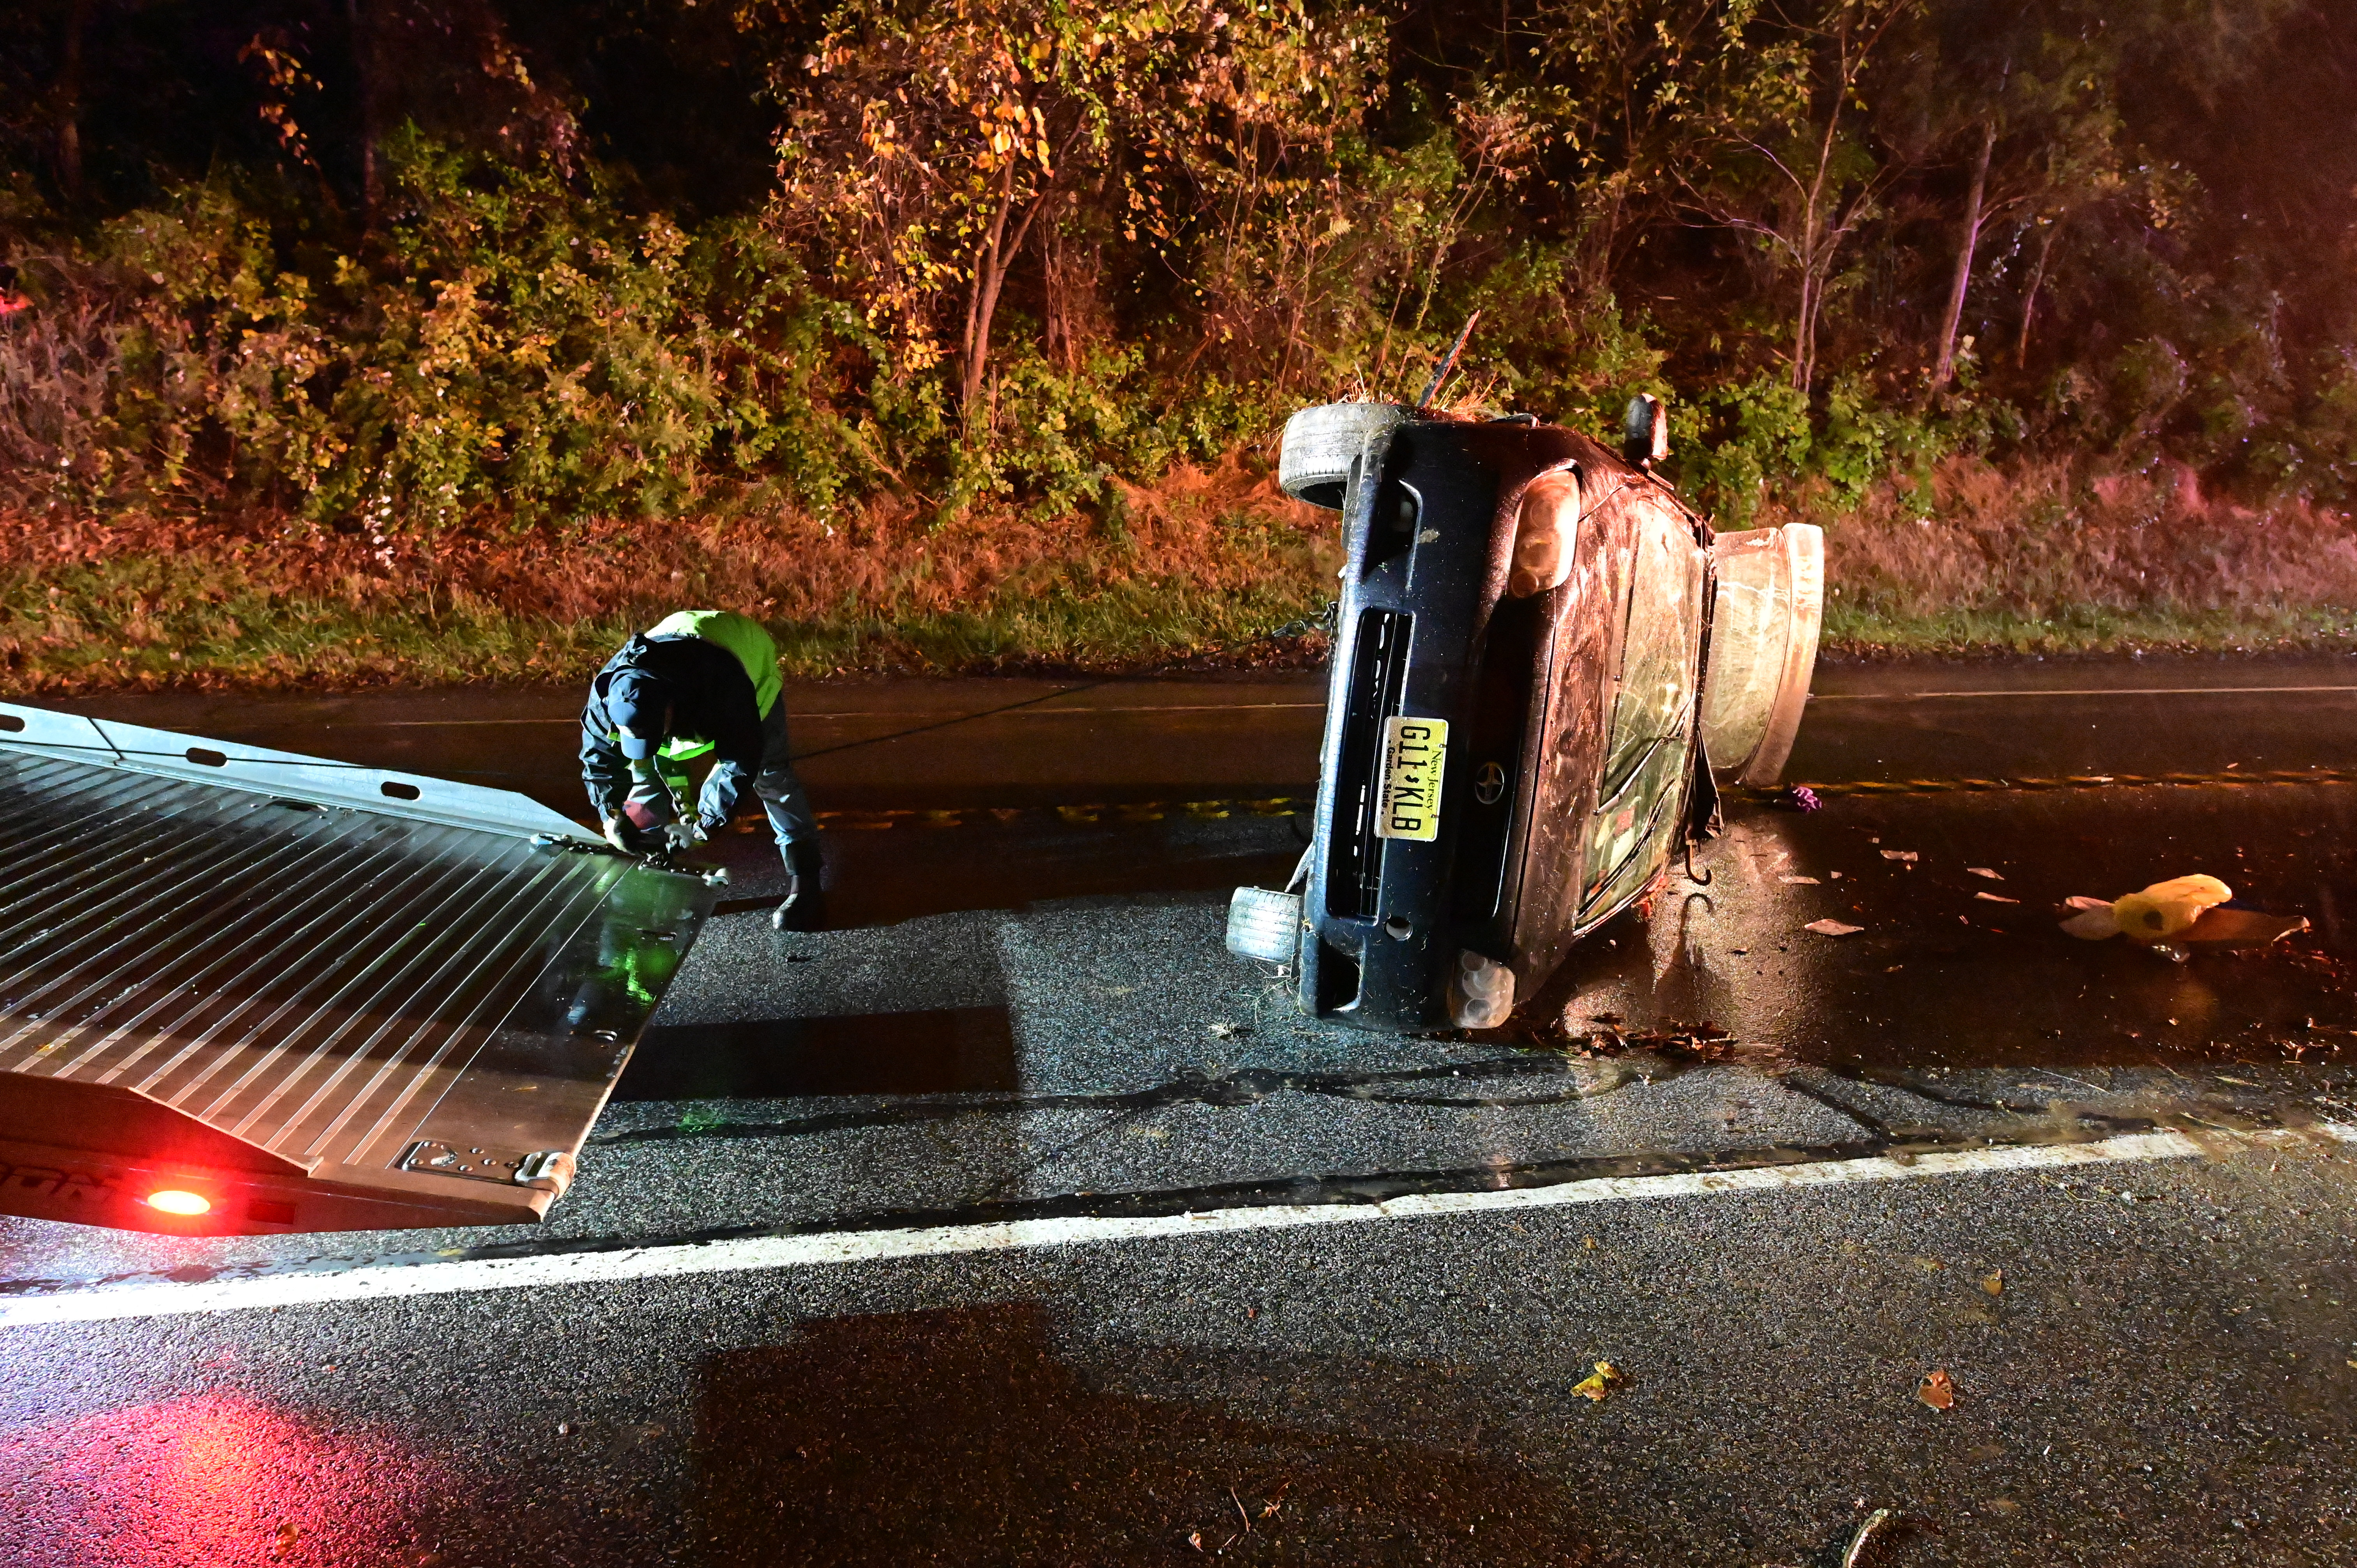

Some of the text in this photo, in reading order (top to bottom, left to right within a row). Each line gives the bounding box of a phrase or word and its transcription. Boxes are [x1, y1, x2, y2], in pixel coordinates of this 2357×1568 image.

[1382, 747, 1395, 808] Garden State
[1391, 726, 1430, 830] G11 KLB
[1424, 750, 1442, 810] New Jersey
